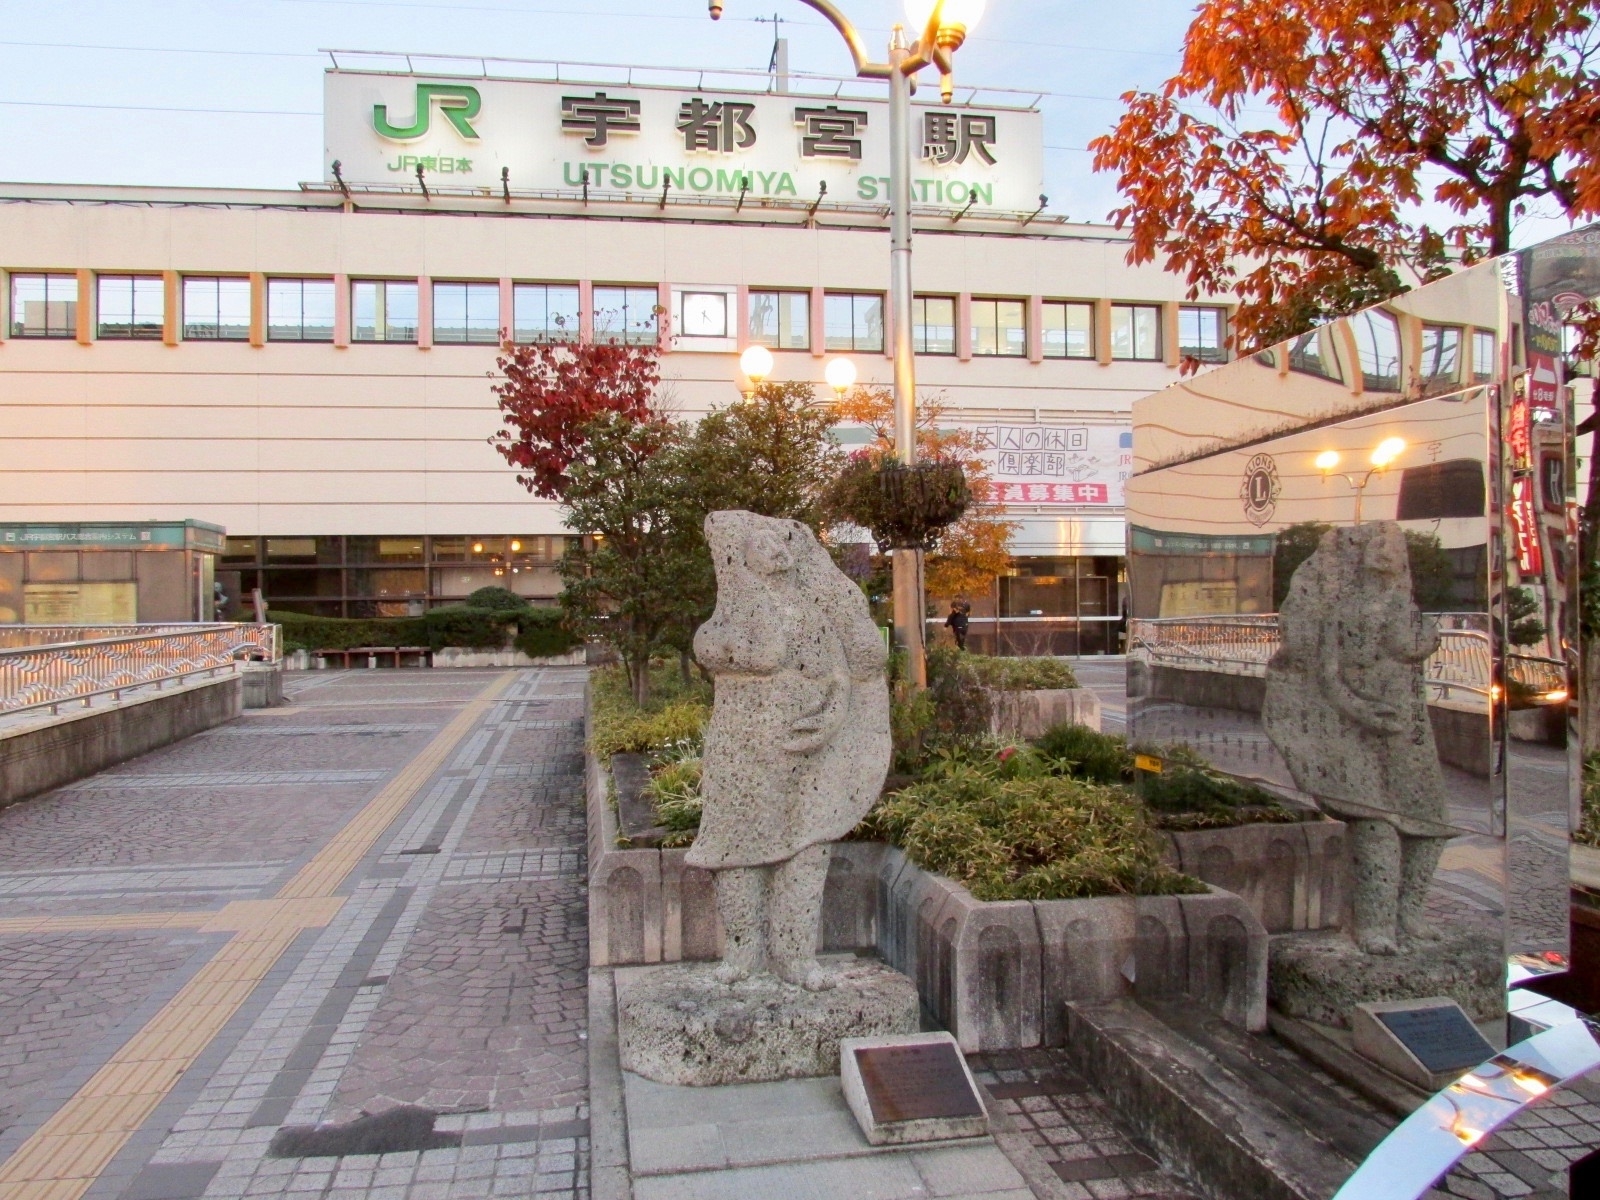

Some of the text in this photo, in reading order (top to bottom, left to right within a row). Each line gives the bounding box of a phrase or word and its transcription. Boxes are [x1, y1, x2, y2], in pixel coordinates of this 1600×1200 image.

[373, 83, 482, 142] JR
[560, 91, 998, 167] 宇都宮駅
[386, 154, 473, 175] JR東日本
[563, 161, 993, 206] UTSUNOMIYA STTION
[977, 427, 1085, 451] 大人の休日
[999, 452, 1065, 477] 倶楽部
[1248, 456, 1273, 473] LIONS
